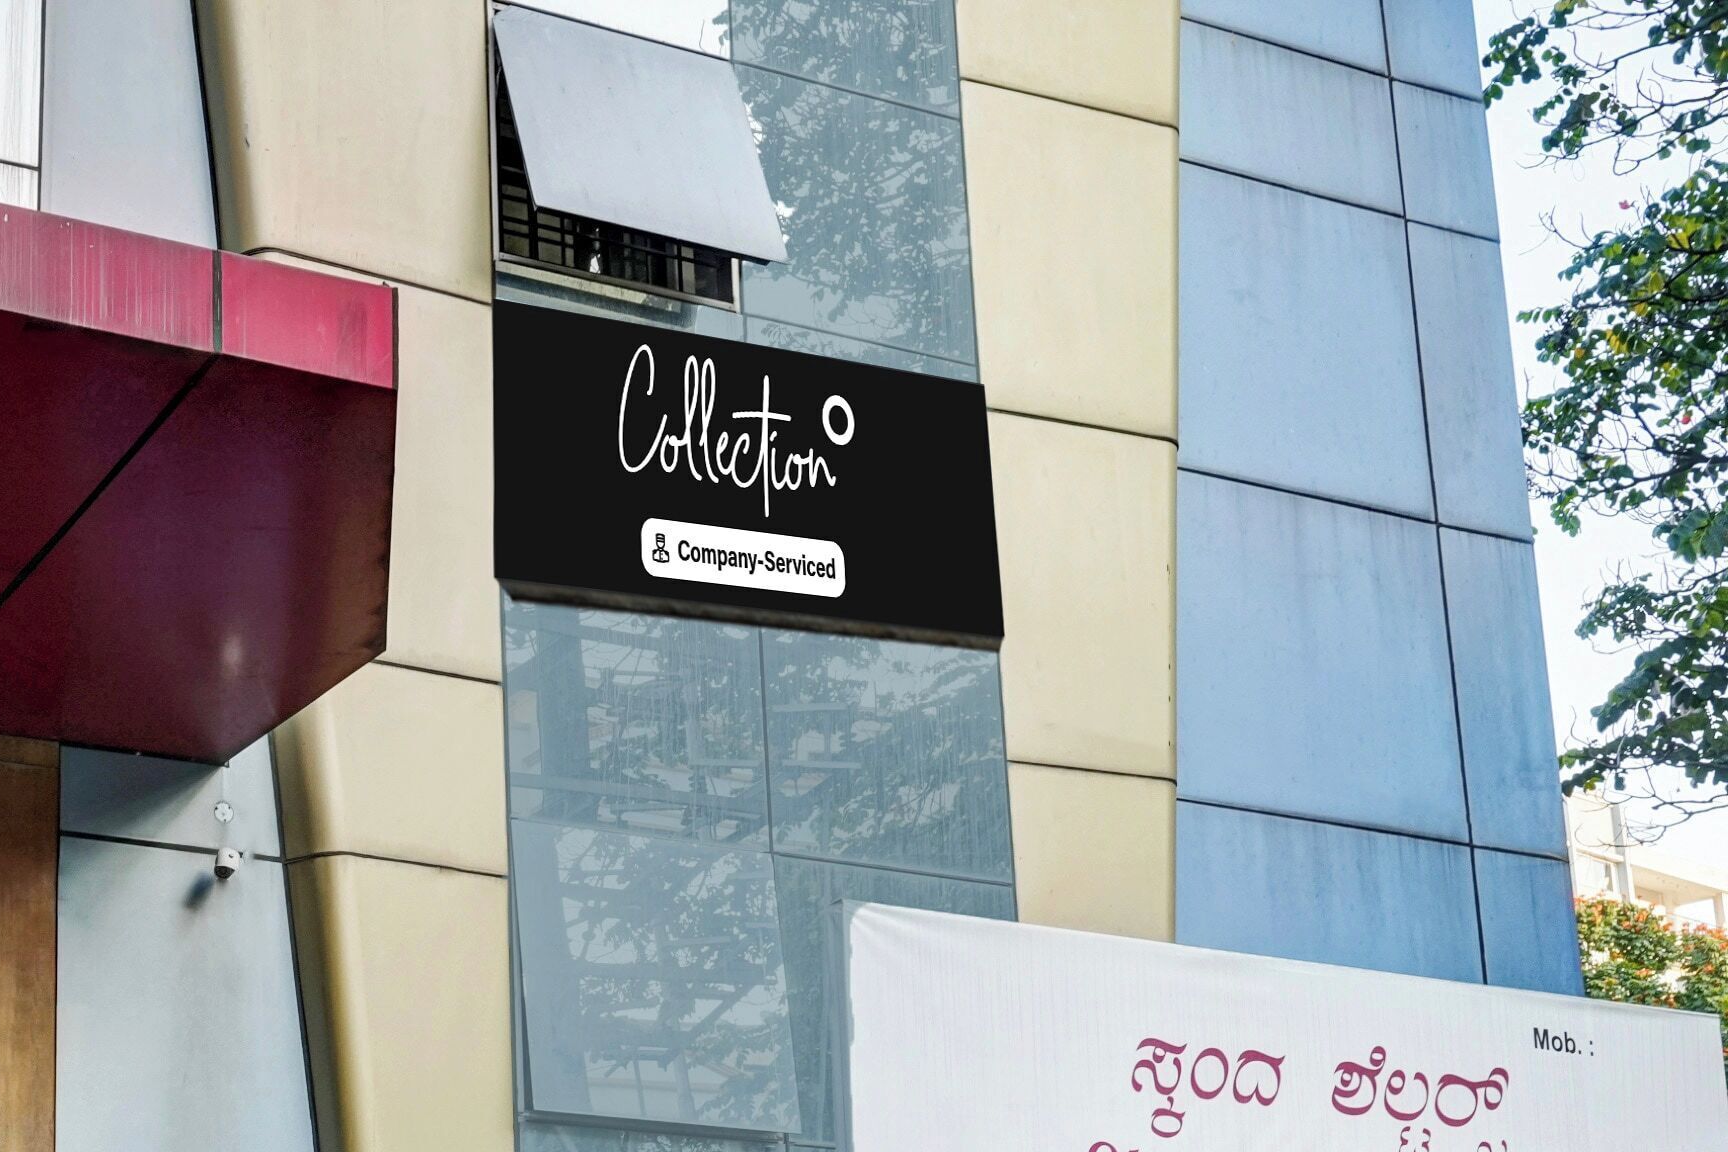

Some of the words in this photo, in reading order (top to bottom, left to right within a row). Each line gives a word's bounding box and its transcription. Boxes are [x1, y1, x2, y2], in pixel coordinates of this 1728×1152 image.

[618, 343, 837, 518] Collection
[677, 539, 836, 580] Company-Serviced
[1533, 1027, 1582, 1055] Mob.
[1131, 1037, 1286, 1139] ಸ್ಕಂದ
